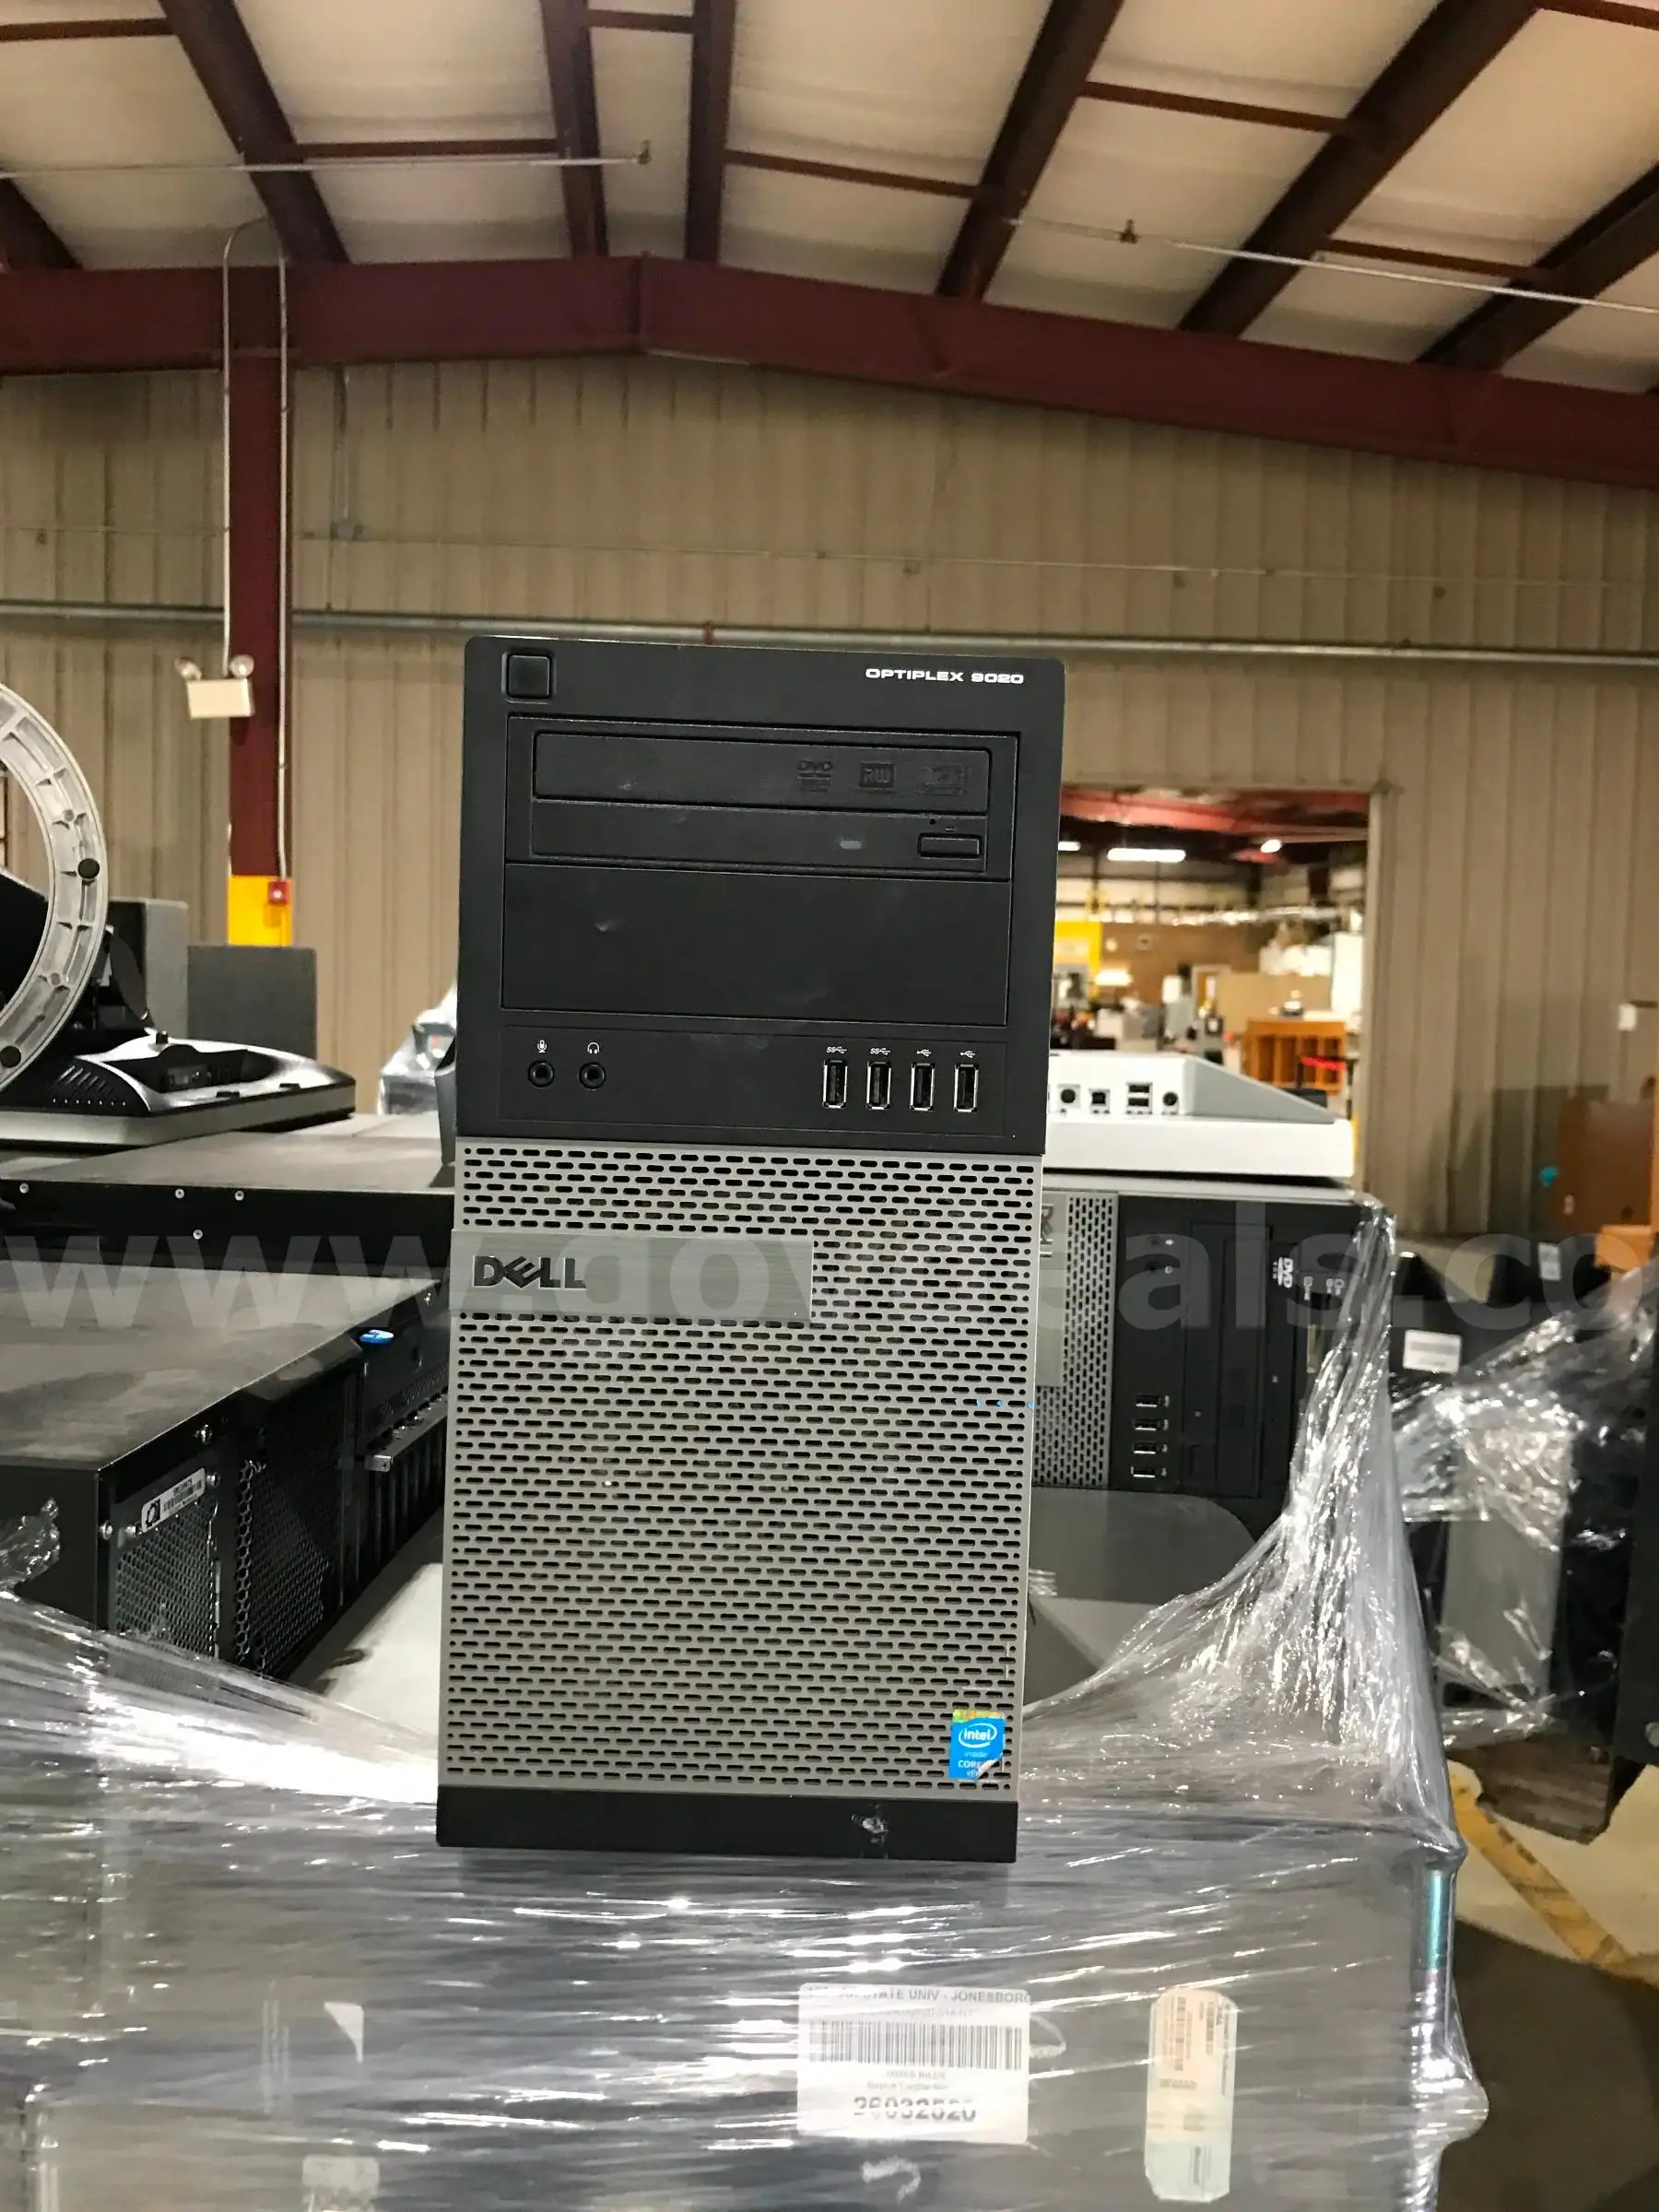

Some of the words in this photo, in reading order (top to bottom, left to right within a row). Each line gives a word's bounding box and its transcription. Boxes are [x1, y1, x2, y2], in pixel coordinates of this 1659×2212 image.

[865, 668, 964, 682] OPTIPLEX
[971, 673, 1025, 684] 9020
[472, 1254, 586, 1289] DELL
[909, 1989, 939, 2000] UNIV
